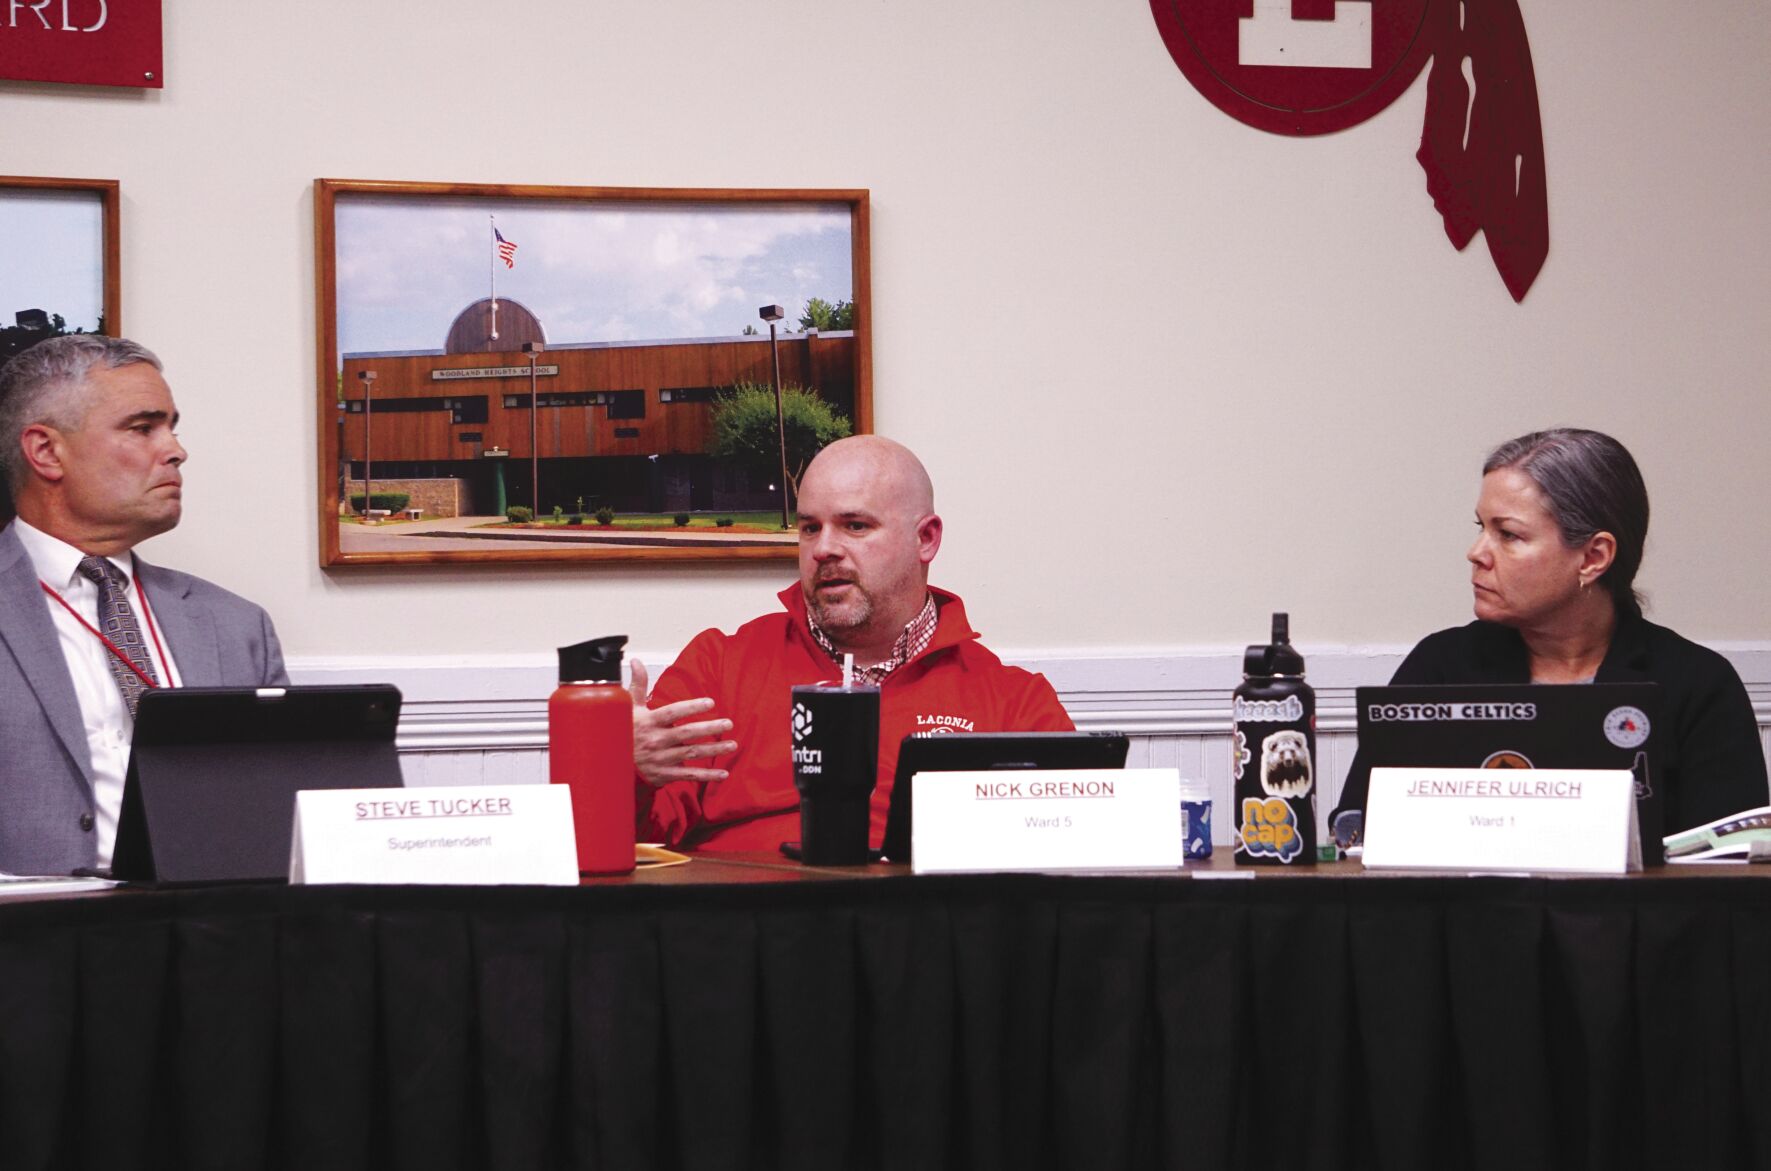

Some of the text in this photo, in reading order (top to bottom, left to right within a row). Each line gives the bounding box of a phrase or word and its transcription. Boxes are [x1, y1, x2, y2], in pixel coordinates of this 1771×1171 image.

[484, 368, 517, 376] HEIGHTS
[520, 366, 551, 375] SCOOL
[1369, 703, 1537, 721] BOSTON CELTICS
[916, 714, 974, 732] LACONIA
[975, 781, 1115, 798] NICK GRENON
[1407, 780, 1582, 797] JENNIFER ULRICH
[355, 797, 513, 818] STEVE TUCKER
[1024, 815, 1073, 829] Ward 5
[1469, 815, 1515, 828] Ward 1
[387, 835, 492, 851] Superintendent
